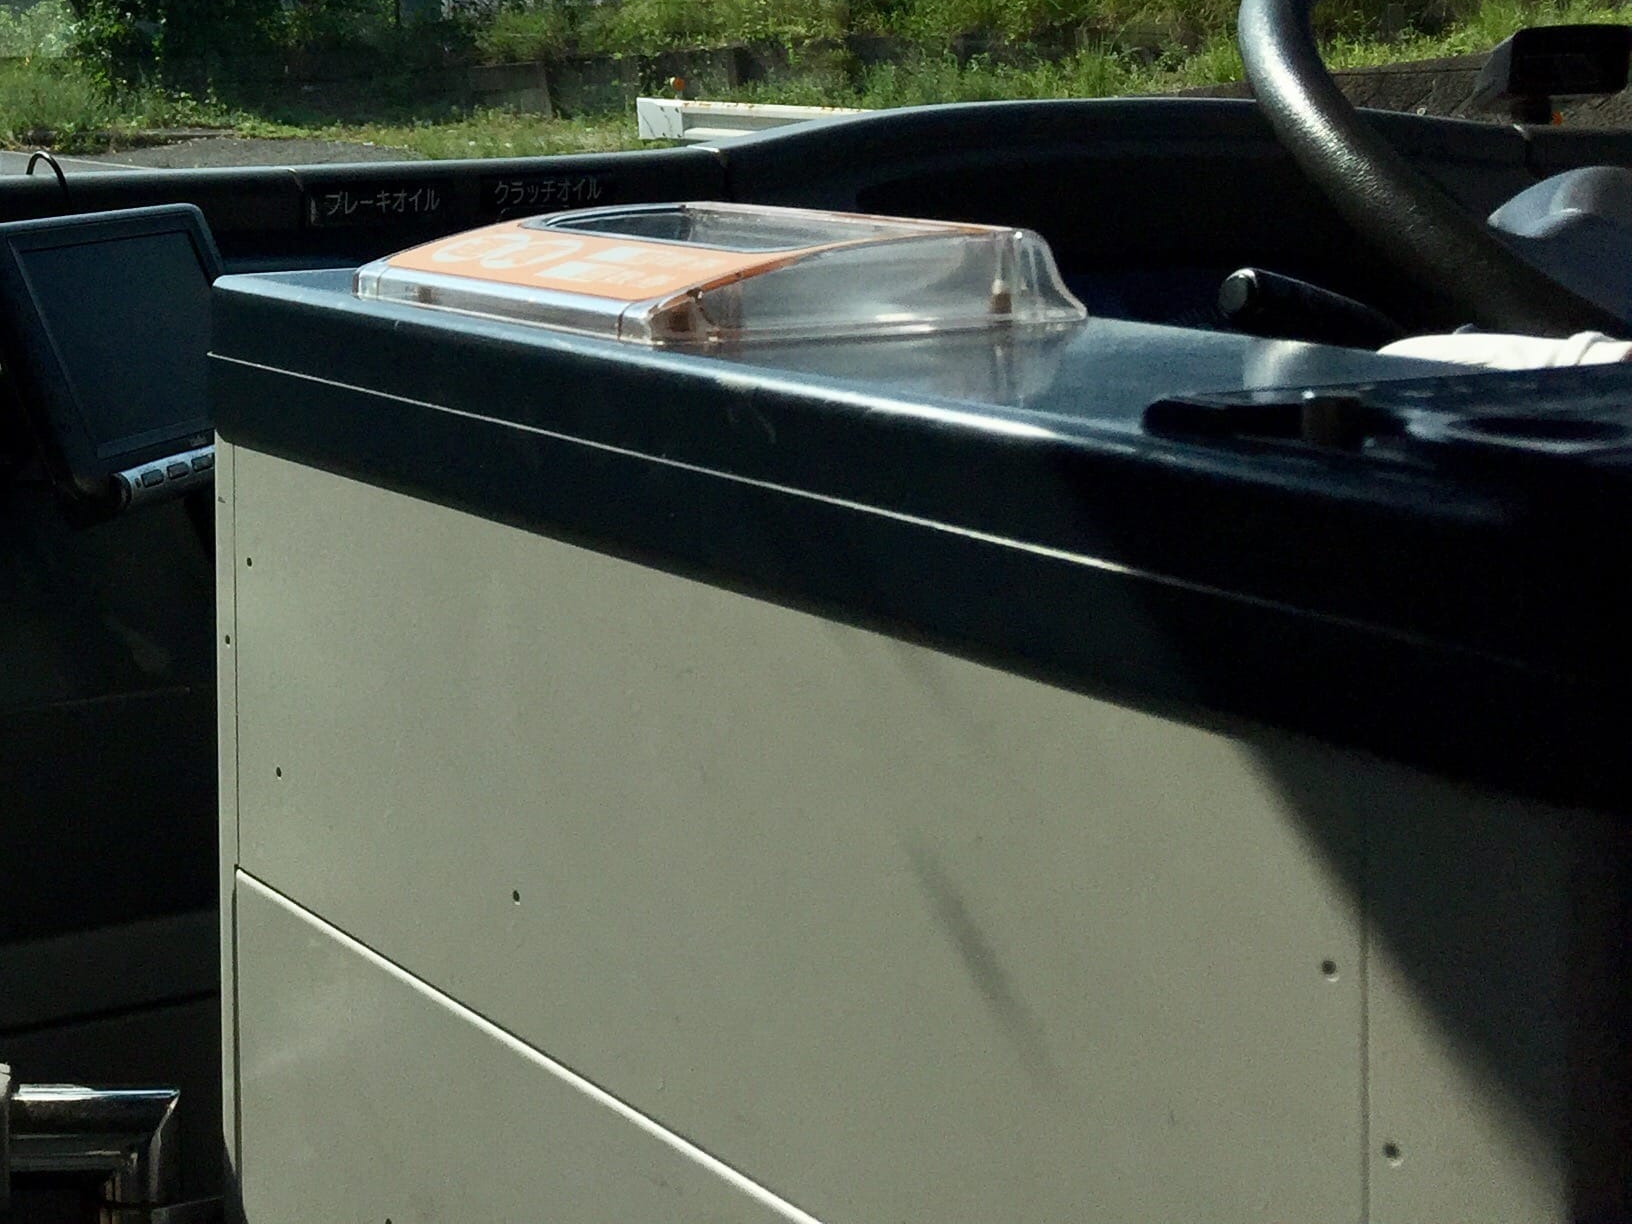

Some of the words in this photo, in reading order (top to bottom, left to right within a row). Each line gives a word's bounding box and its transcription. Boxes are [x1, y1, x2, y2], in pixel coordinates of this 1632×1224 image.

[325, 188, 441, 216] ブレーキオイル
[494, 177, 602, 205] クラッチオイル
